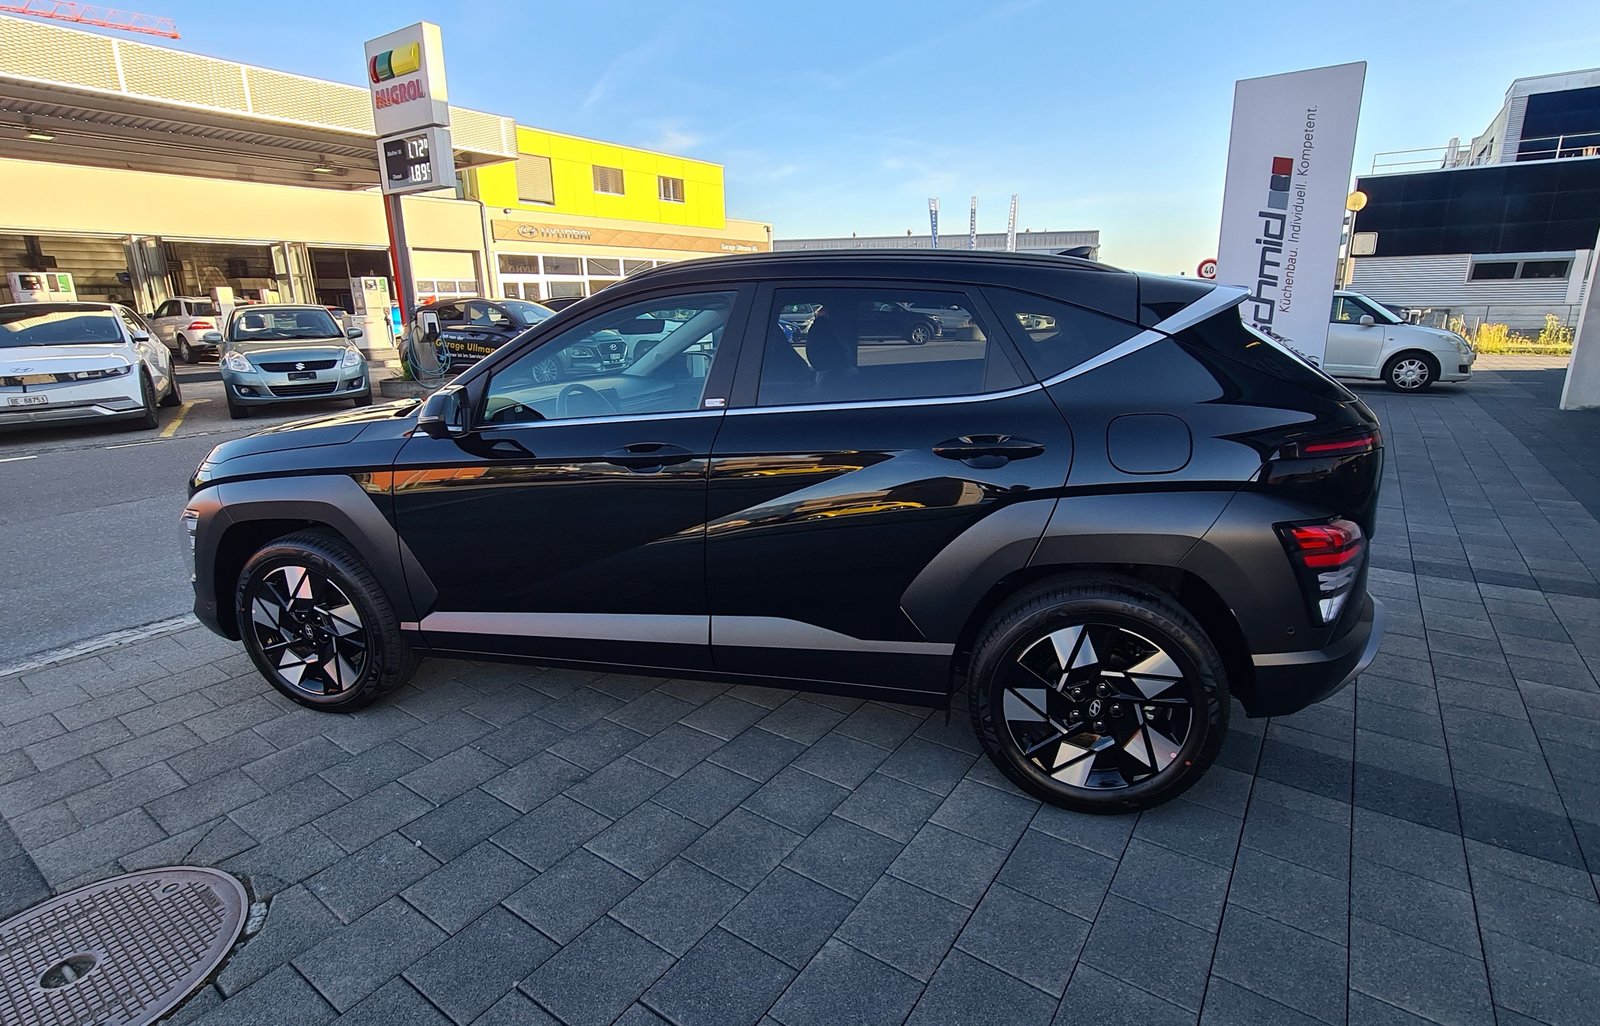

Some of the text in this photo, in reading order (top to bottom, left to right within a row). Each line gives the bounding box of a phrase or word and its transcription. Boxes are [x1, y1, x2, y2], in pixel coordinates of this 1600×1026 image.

[375, 79, 425, 109] MIGROL
[1278, 105, 1318, 313] Küchenbau. Individuell. Kompetent.
[541, 227, 591, 240] HYUNDAI
[1204, 266, 1215, 274] 40
